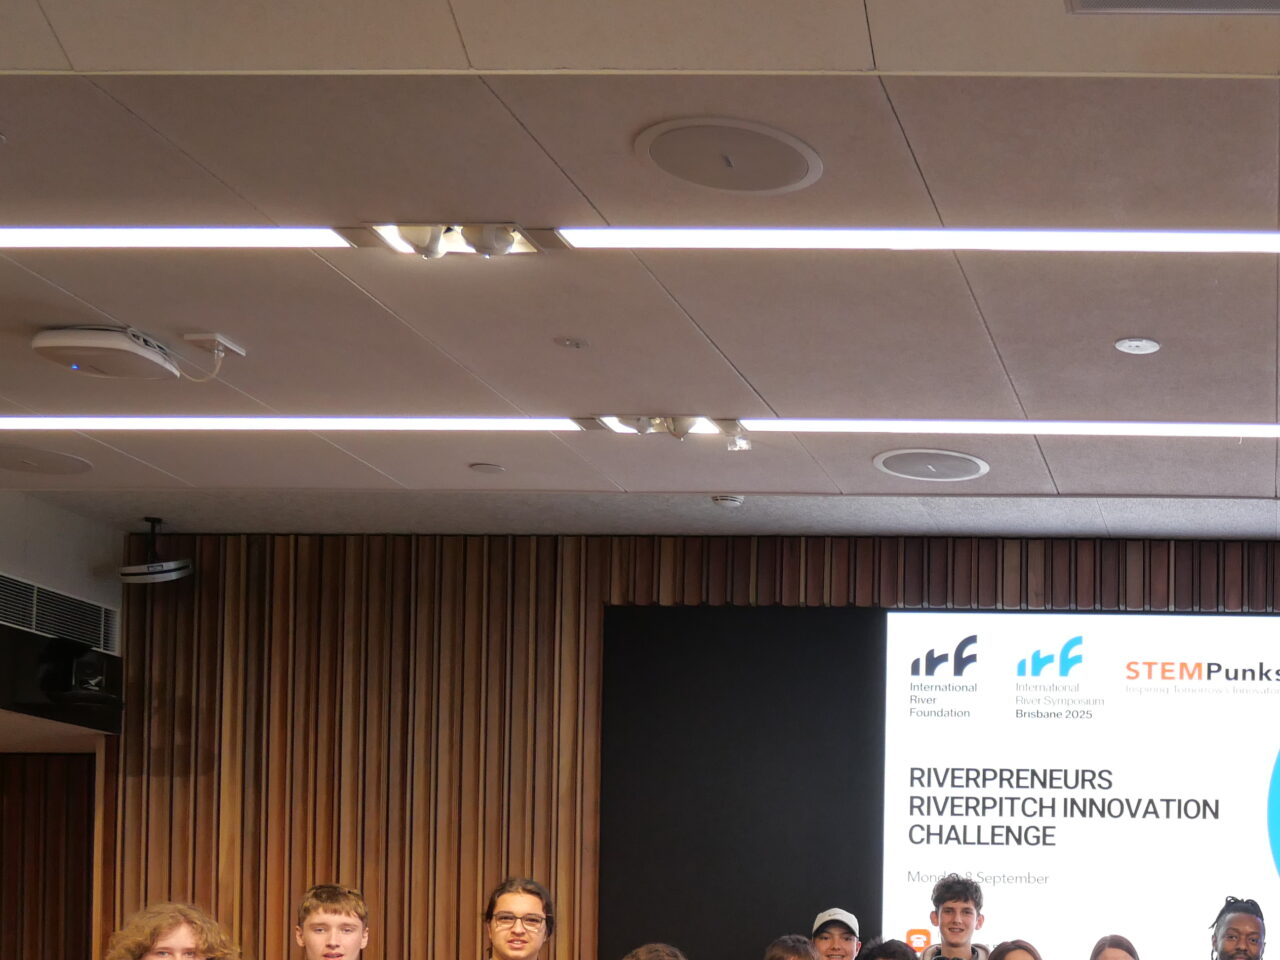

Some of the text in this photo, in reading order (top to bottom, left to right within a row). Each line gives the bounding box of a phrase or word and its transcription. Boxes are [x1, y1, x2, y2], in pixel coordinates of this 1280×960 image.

[910, 682, 977, 692] International
[1016, 682, 1080, 692] International
[910, 695, 936, 705] River
[1015, 696, 1105, 707] River Symposium
[909, 708, 970, 718] Foundation
[1016, 709, 1093, 720] Brisbane 2025
[909, 767, 1113, 790] RIVERPRENEURS
[909, 796, 1220, 820] RIVERPITCH INNOVATION
[908, 824, 1056, 846] CHALLENGE
[907, 871, 962, 884] Mond
[976, 872, 1049, 886] September
